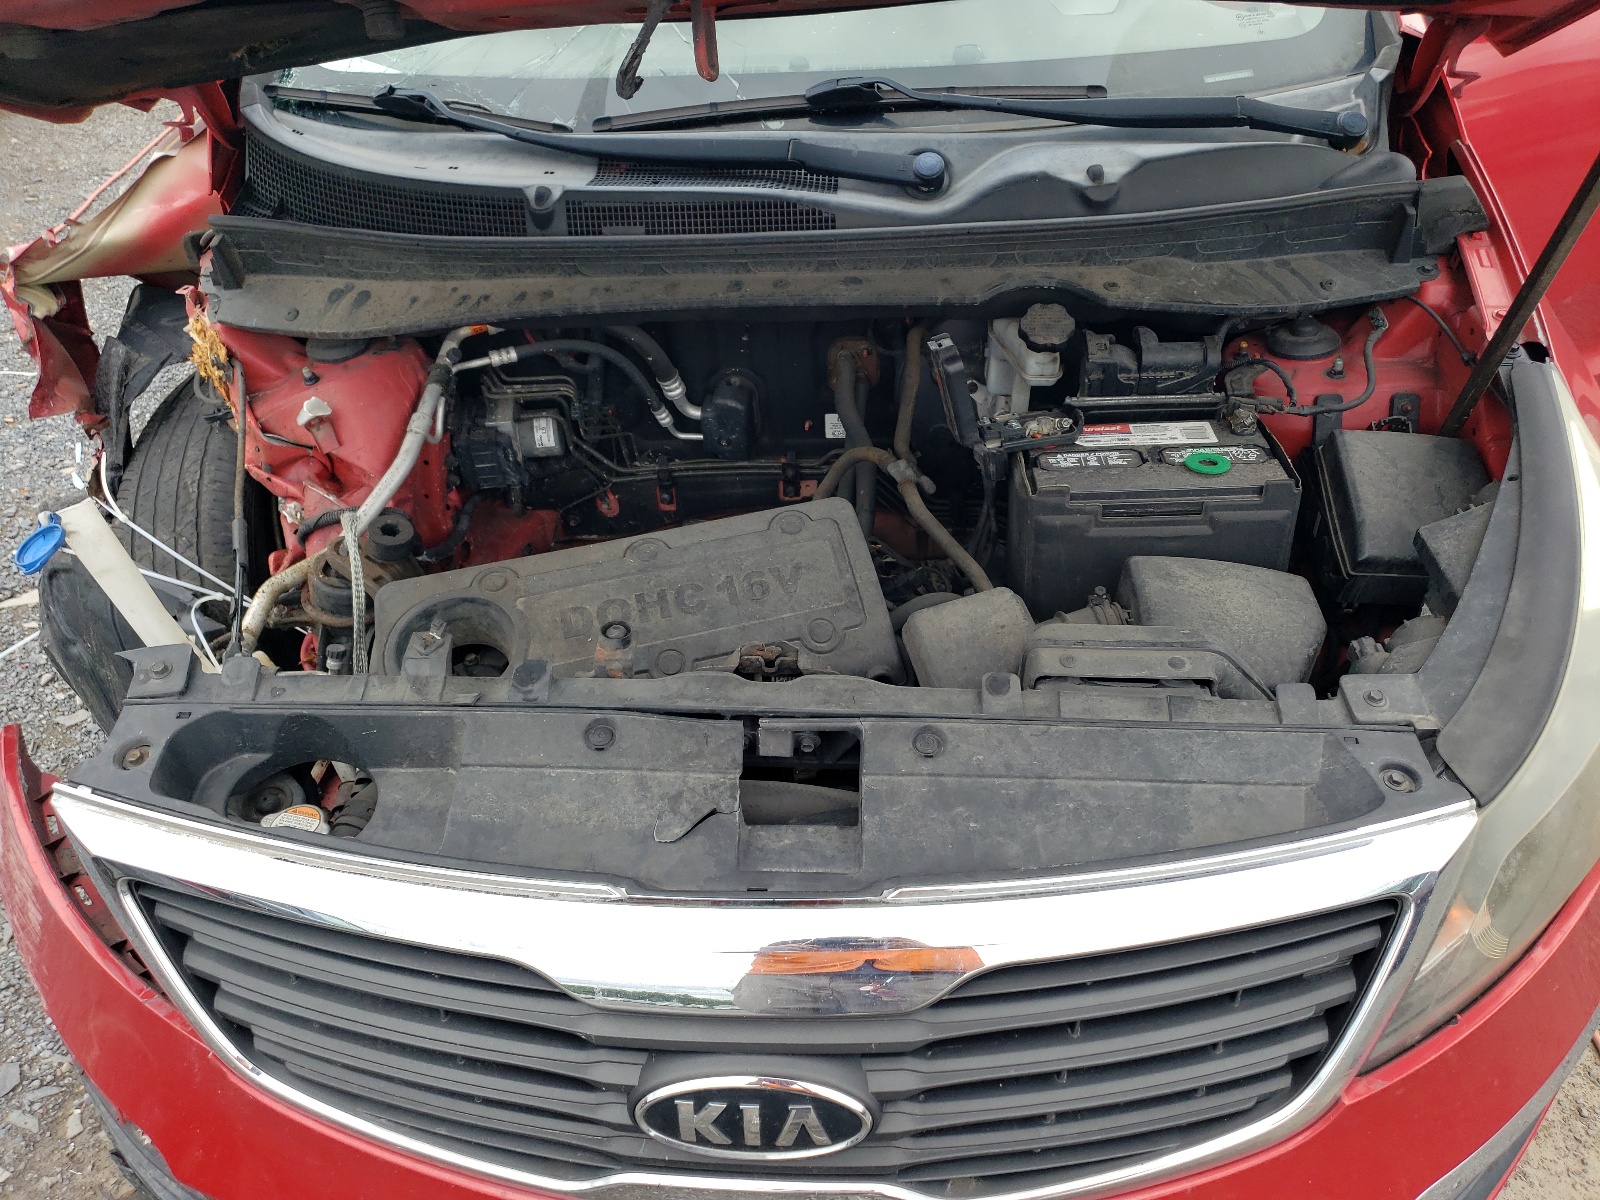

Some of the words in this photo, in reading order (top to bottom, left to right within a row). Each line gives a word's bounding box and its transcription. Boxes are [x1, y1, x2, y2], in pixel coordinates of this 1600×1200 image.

[560, 583, 704, 640] DOHC
[715, 564, 801, 607] 16V
[674, 1100, 832, 1146] KIA
